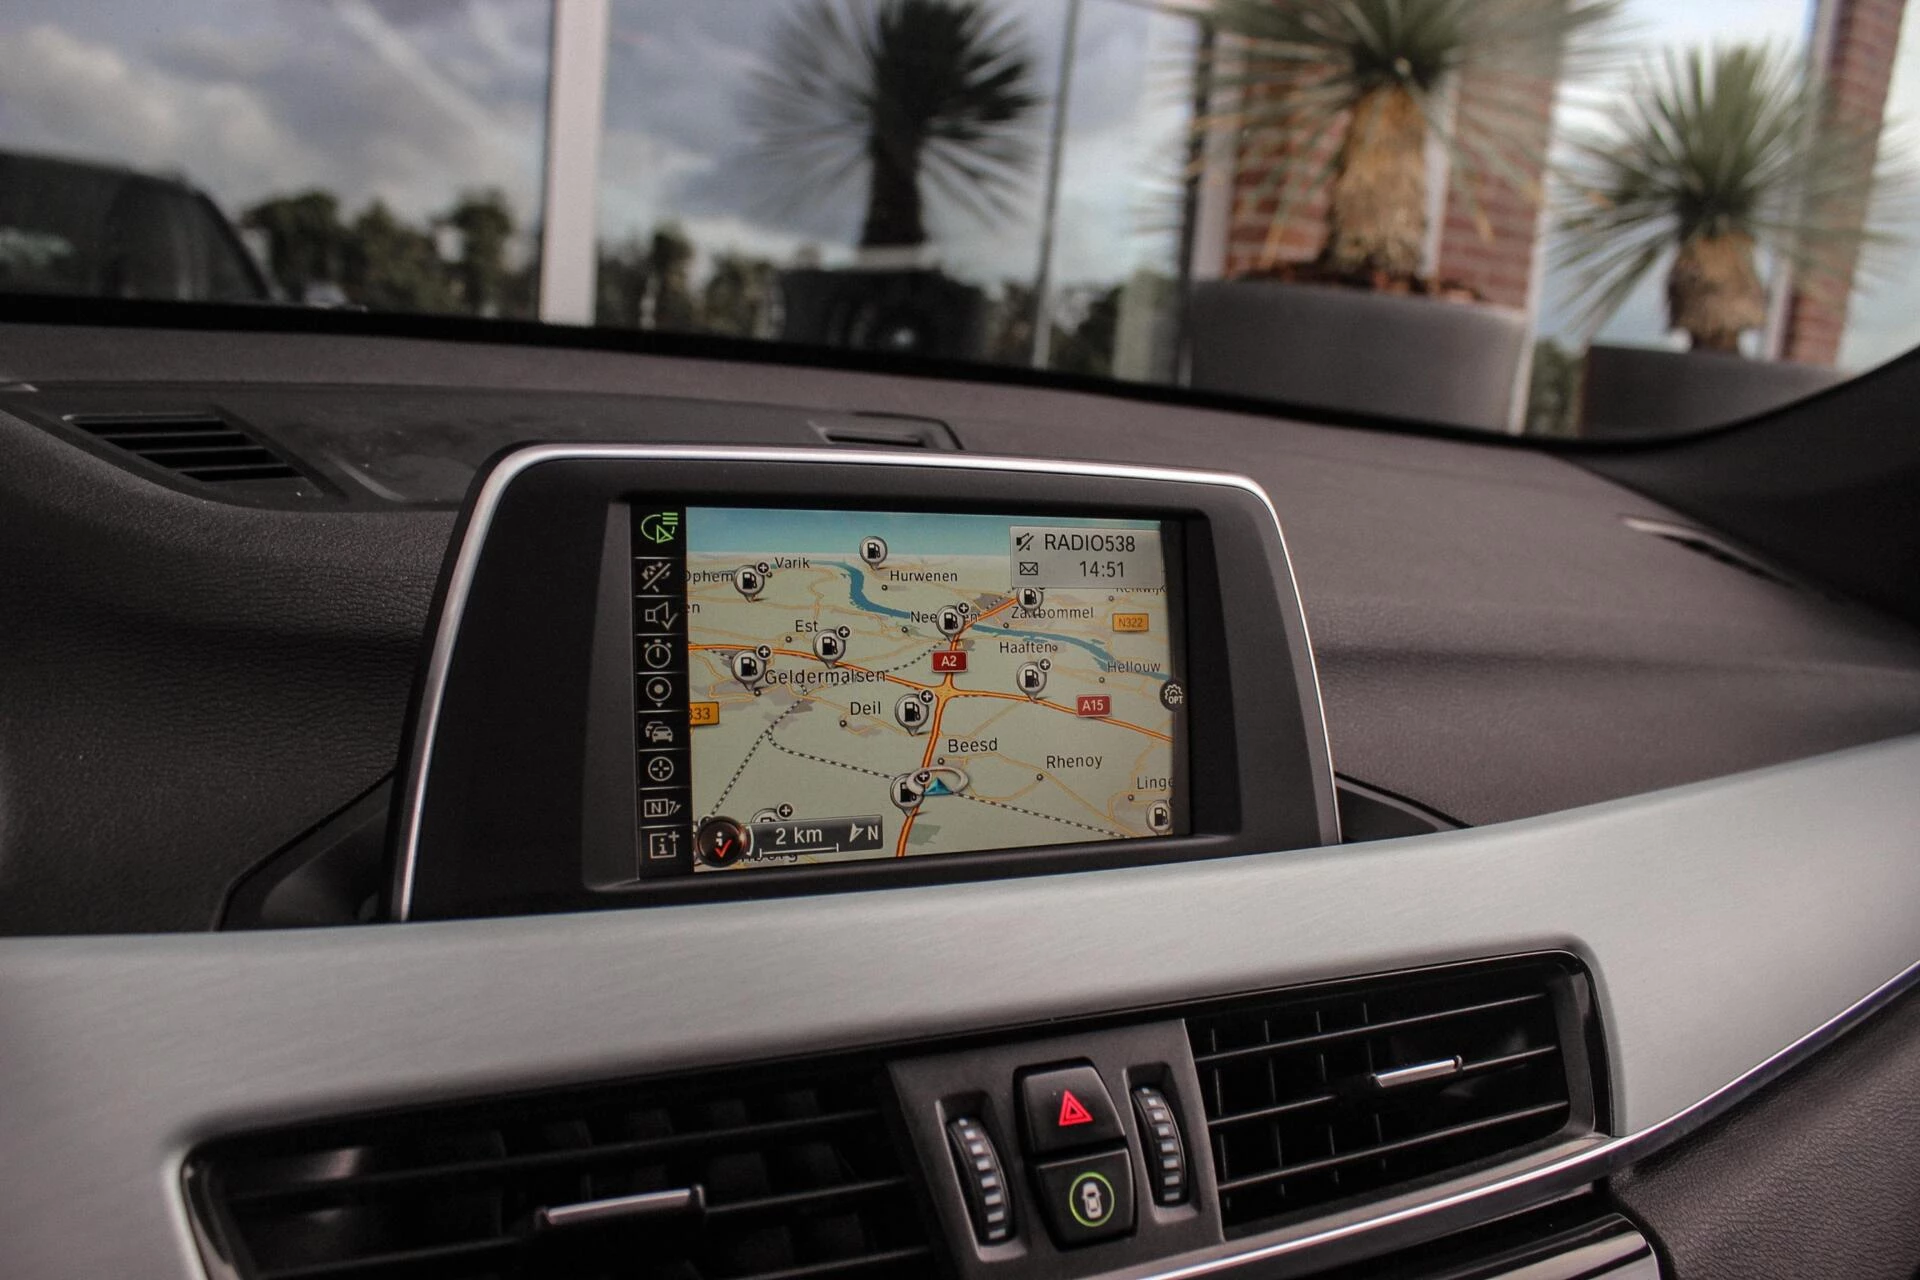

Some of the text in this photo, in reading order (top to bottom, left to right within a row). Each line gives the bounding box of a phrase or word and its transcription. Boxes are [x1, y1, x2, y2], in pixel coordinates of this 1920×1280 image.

[1045, 533, 1136, 553] RADIO538
[774, 557, 810, 570] Varik
[1079, 560, 1124, 578] 14:51
[890, 570, 958, 583] Hurwenen
[1011, 606, 1095, 620] Zatbommel
[795, 619, 819, 633] Est
[1118, 617, 1143, 628] N322
[1000, 641, 1052, 654] Haaften
[941, 656, 957, 668] A2
[1107, 660, 1161, 673] Hellouw
[765, 669, 886, 685] Geldermalsen
[1082, 699, 1104, 712] A15
[1168, 696, 1184, 705] OPT
[850, 701, 881, 716] Deil
[948, 737, 998, 753] Beesd
[1046, 755, 1103, 770] Rhenoy
[775, 826, 823, 845] 2 km
[867, 825, 879, 841] N
